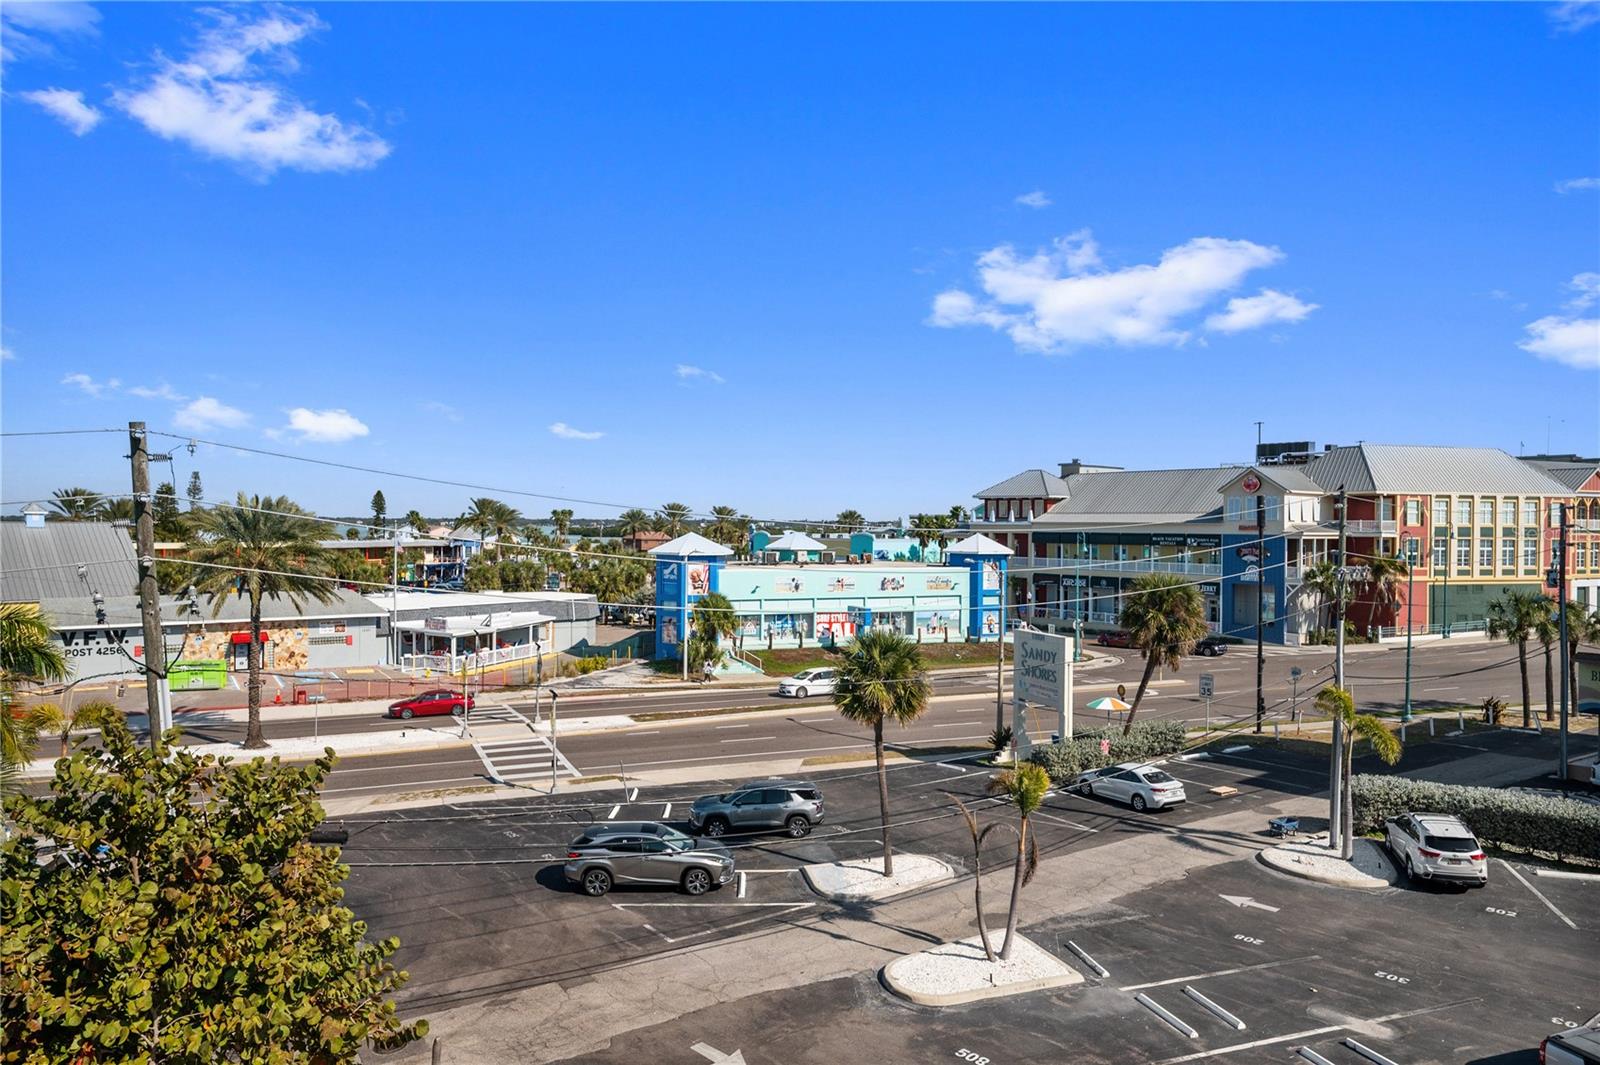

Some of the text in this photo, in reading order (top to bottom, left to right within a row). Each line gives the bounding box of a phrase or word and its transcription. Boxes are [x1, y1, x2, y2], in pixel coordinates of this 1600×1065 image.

[60, 629, 129, 647] V.F.W.
[816, 622, 856, 643] SAL
[64, 646, 123, 658] POST 4256
[1020, 641, 1057, 664] SANDY
[1020, 659, 1057, 683] SHORES
[1591, 670, 1600, 681] B
[1200, 687, 1212, 697] 35
[954, 1048, 990, 1065] 508
